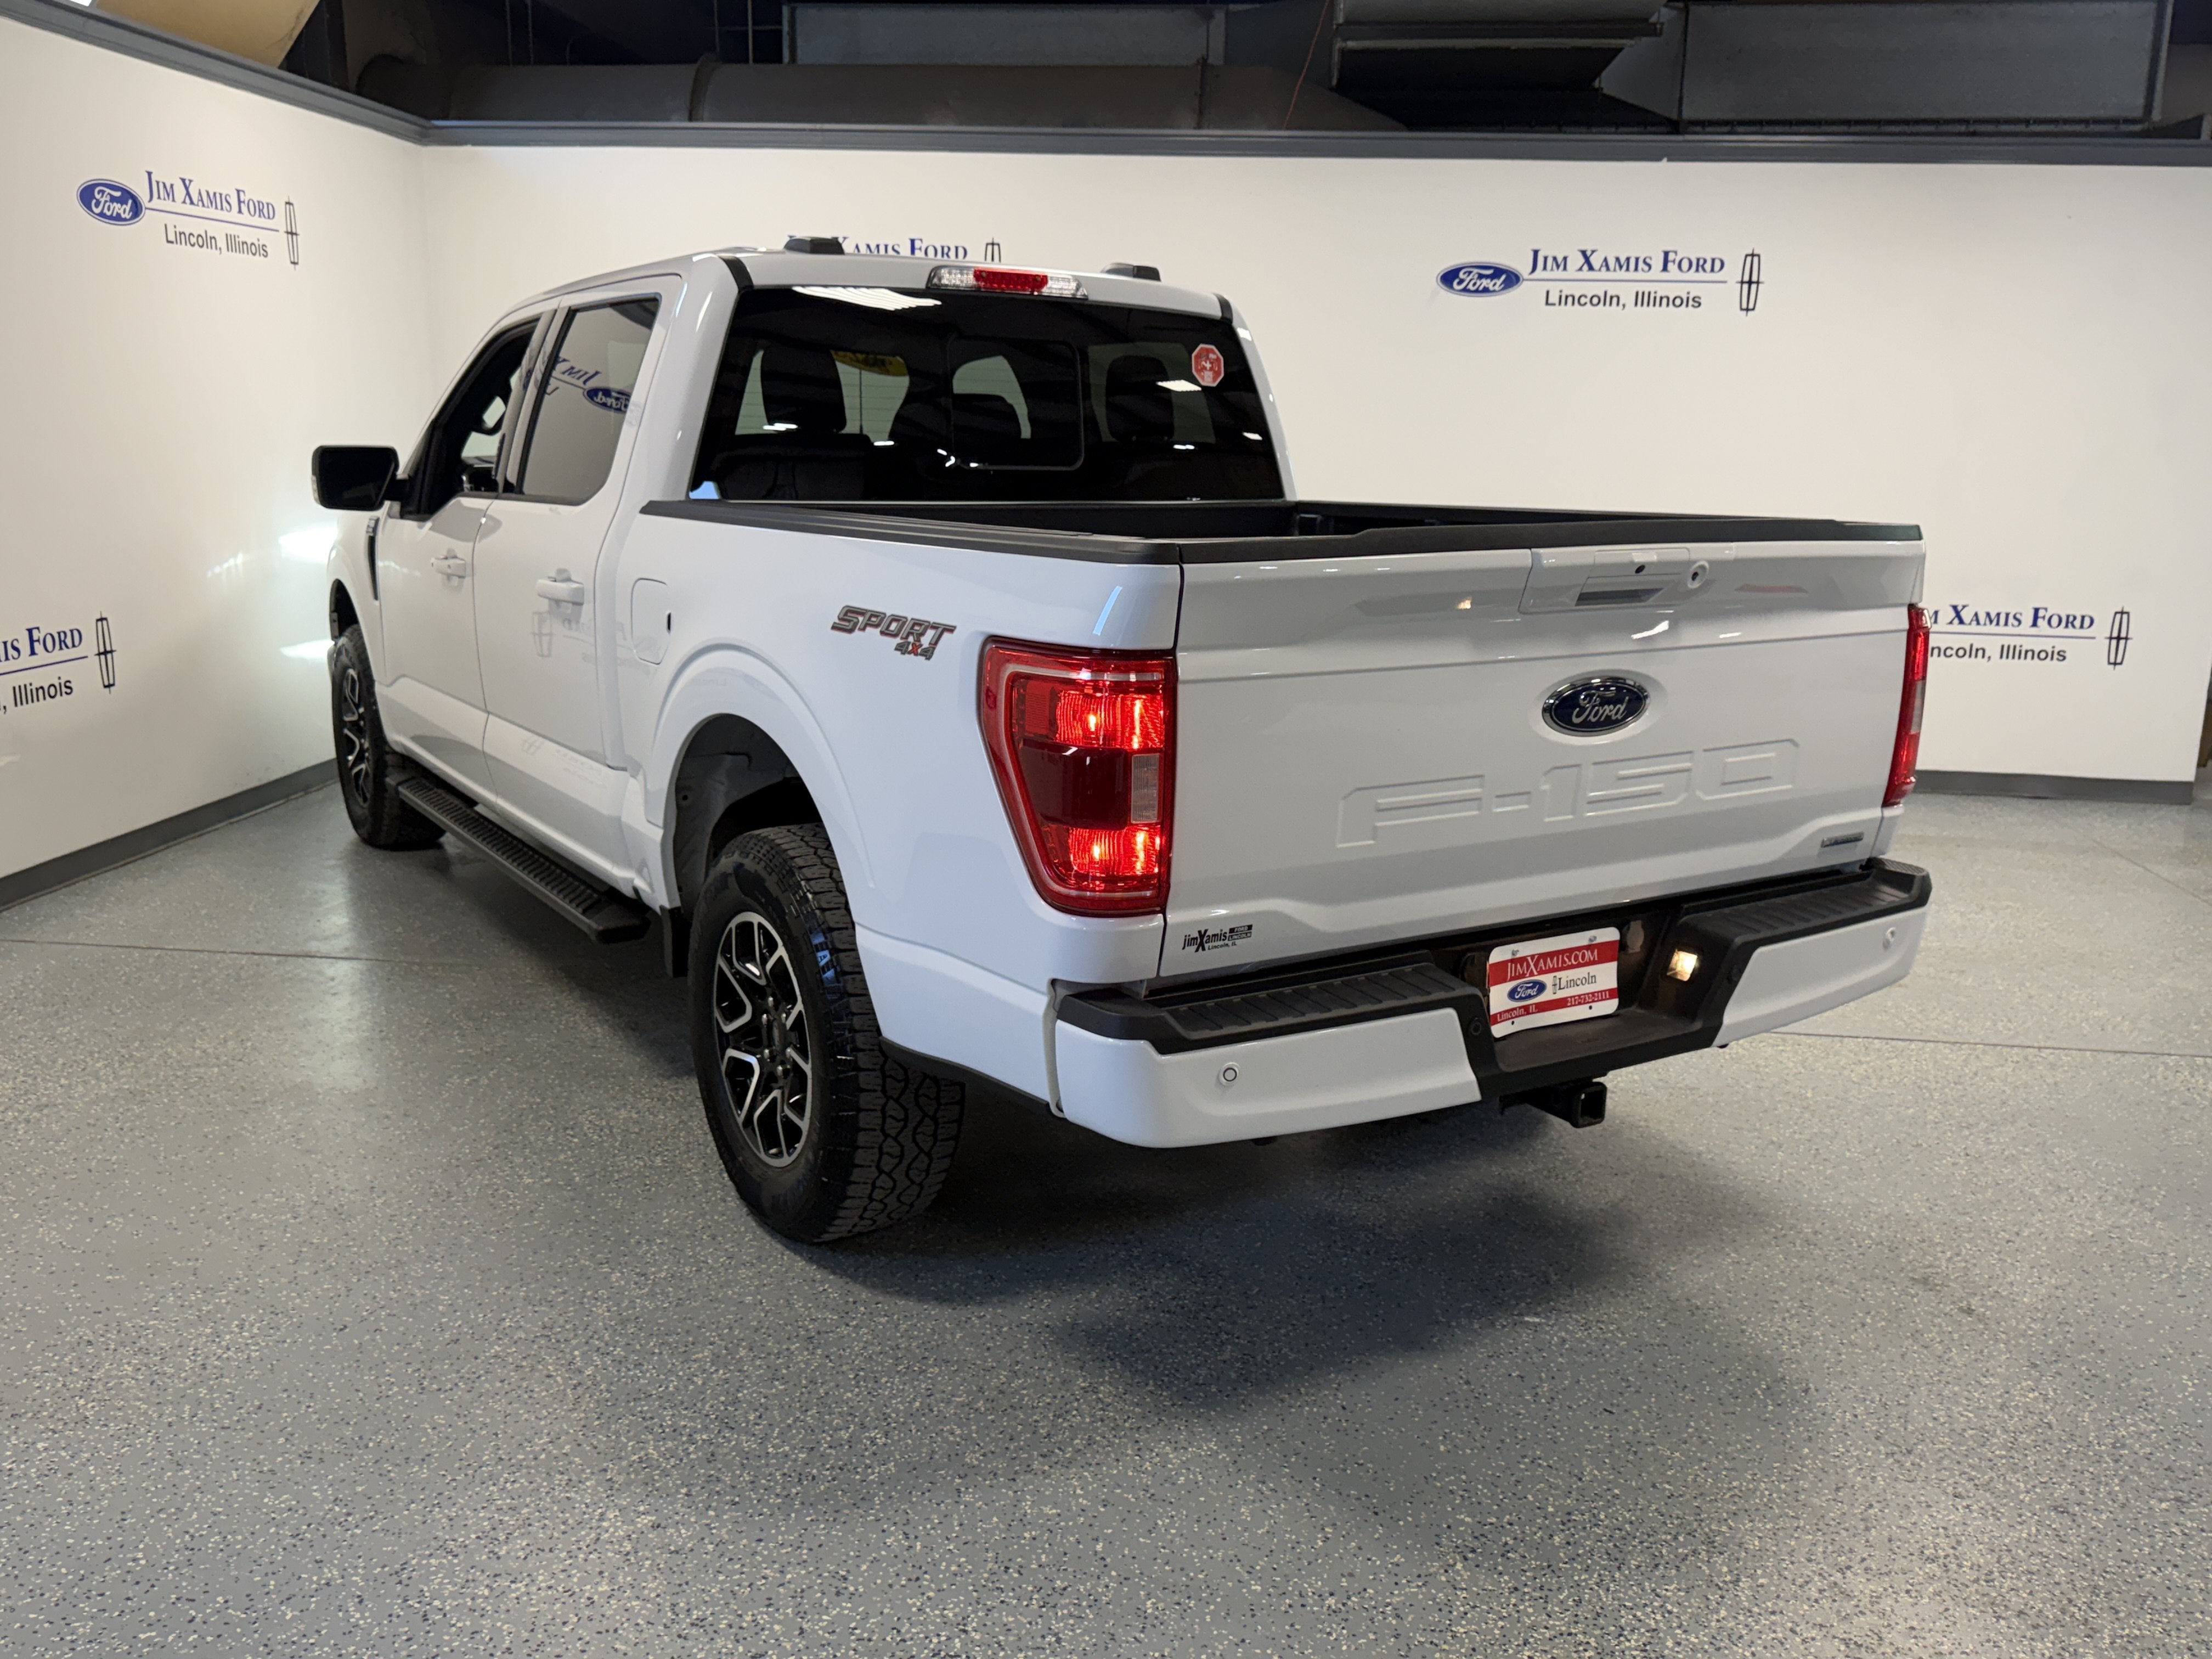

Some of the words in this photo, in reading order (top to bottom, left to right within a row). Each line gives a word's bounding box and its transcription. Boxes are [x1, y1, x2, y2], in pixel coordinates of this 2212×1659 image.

[91, 186, 132, 219] Ford
[145, 171, 176, 203] JIM
[179, 177, 232, 213] XAMIS
[235, 188, 275, 220] FORD
[165, 223, 222, 255] Lincoln,
[225, 233, 268, 258] Illinois
[909, 238, 968, 259] FORD
[1528, 249, 1569, 275] JIM
[1576, 249, 1652, 273] XAMIS
[1661, 250, 1725, 274] FORD
[1453, 267, 1506, 292] Ford
[1545, 290, 1626, 311] Lincoln,
[1634, 291, 1702, 308] Illinois
[831, 605, 957, 647] SPORT
[1946, 605, 2022, 628] XAMIS
[2029, 607, 2095, 630] FORD
[26, 627, 82, 657] FORD
[1930, 643, 1991, 662] ncoln,
[2000, 645, 2067, 662] Illinois
[12, 676, 73, 707] Illinois
[1572, 691, 1629, 725] Ford
[1336, 738, 1800, 849] F-150
[1182, 929, 1227, 952] jimXamis
[1515, 983, 1538, 998] Ford
[1558, 972, 1596, 991] Lincoln
[1567, 991, 1610, 1006] 217-732-2111
